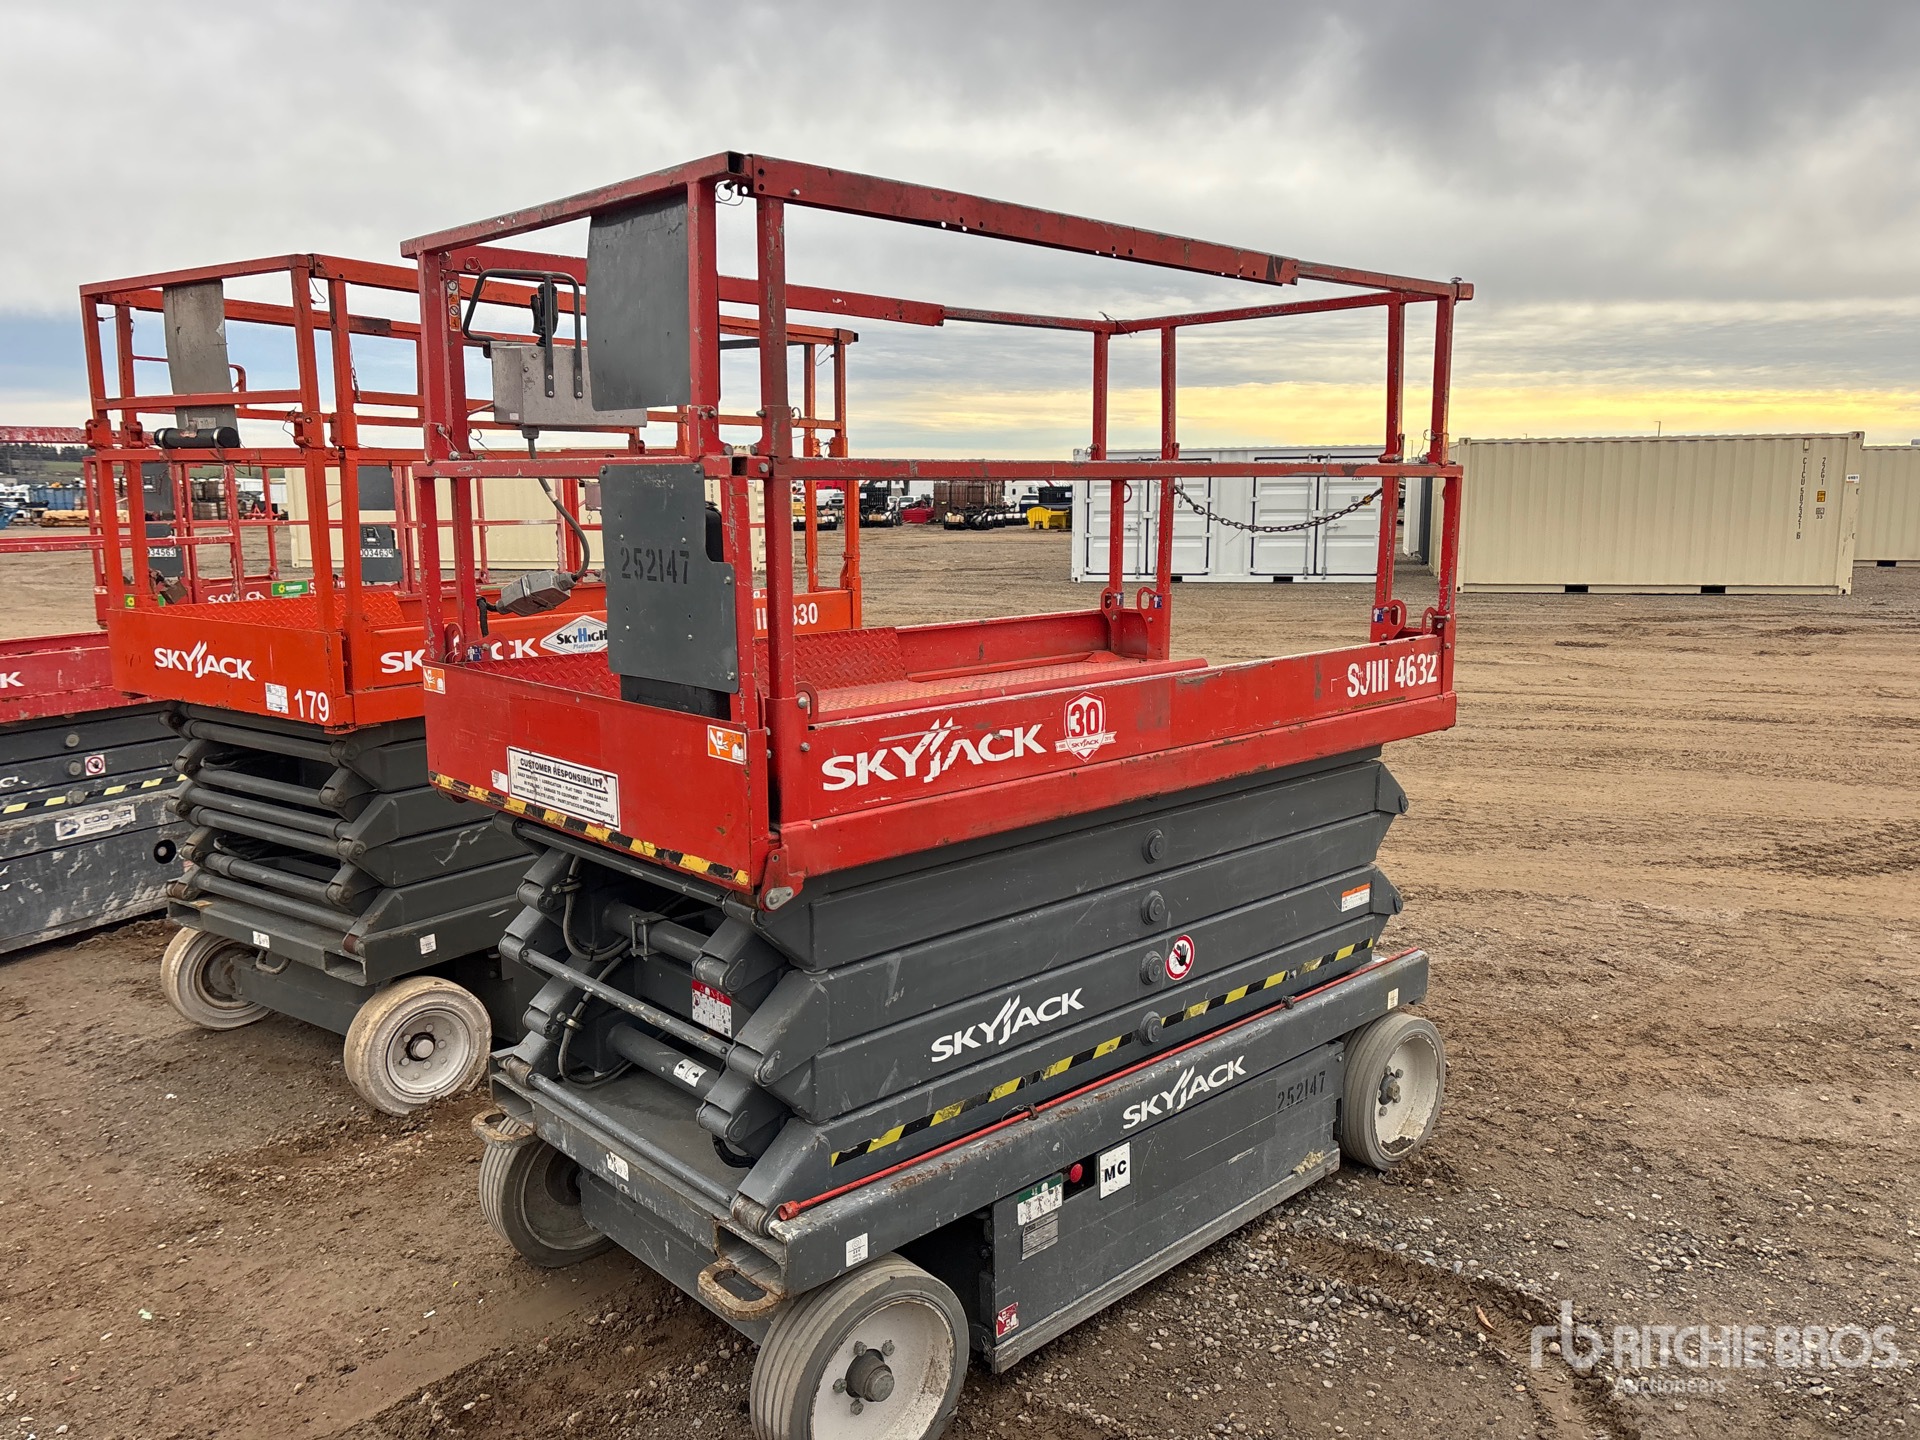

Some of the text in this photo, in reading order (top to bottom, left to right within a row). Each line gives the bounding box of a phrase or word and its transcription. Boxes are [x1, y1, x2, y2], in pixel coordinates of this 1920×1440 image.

[620, 548, 690, 585] 252147
[154, 640, 256, 682] SKYJACK
[1394, 654, 1438, 690] 4632
[294, 688, 330, 722] 179
[1071, 702, 1100, 738] 30
[520, 758, 603, 788] CUSTOMER RESPONSIBILITY
[822, 717, 1047, 793] SKYJACK
[930, 988, 1084, 1063] SKYJACK
[1122, 1056, 1247, 1130] SKYJACK
[1276, 1071, 1326, 1114] 252147
[1104, 1160, 1127, 1182] MC
